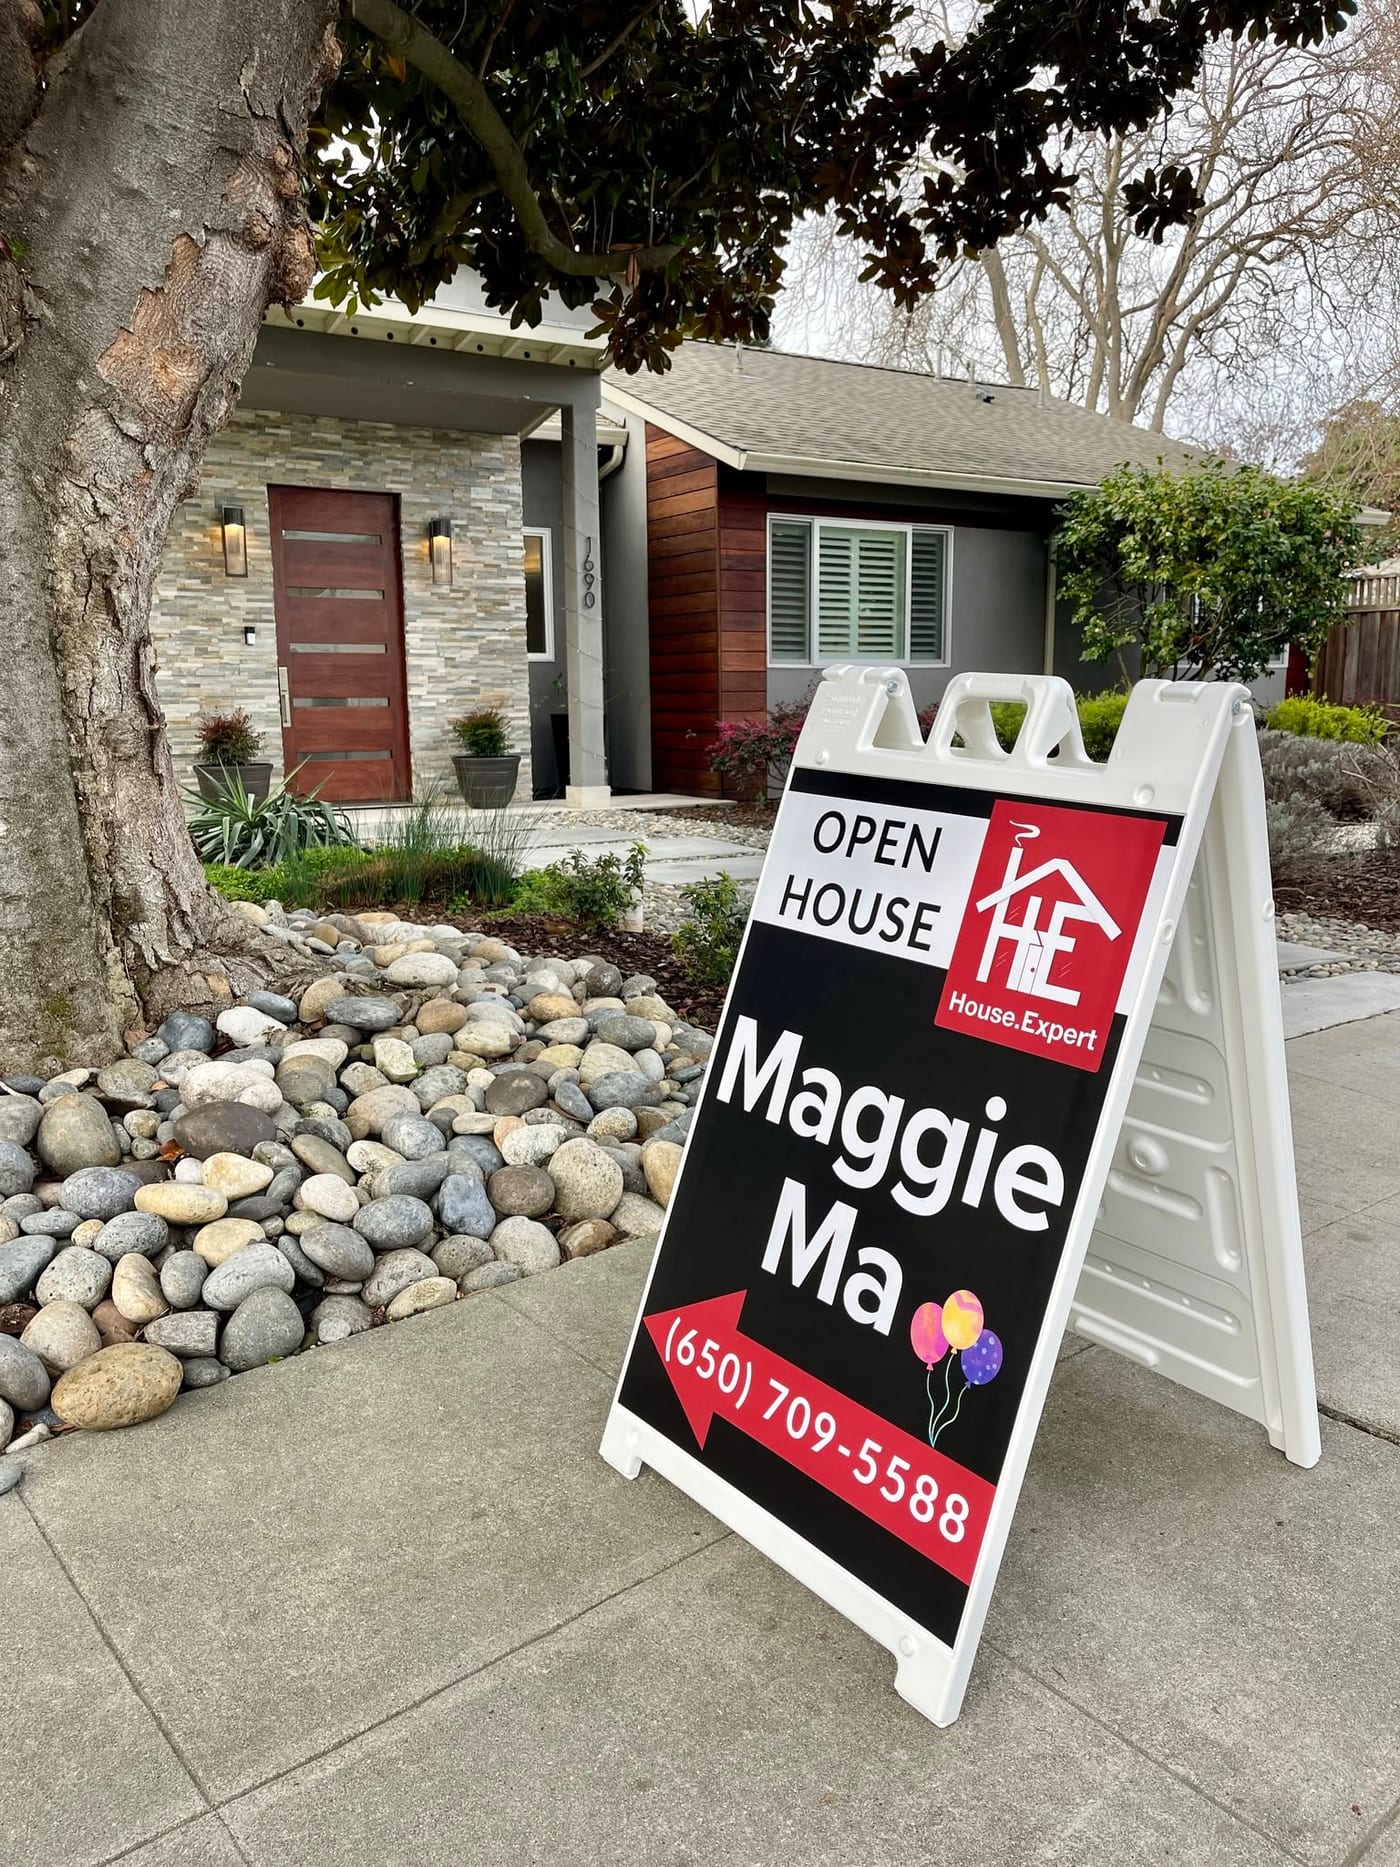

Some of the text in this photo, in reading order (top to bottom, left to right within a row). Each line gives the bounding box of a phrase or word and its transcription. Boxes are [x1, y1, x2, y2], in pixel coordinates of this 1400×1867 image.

[584, 536, 595, 609] 1690
[813, 810, 944, 873] OPEN
[778, 874, 942, 952] HOUSE
[948, 990, 1098, 1051] House.Expert
[716, 1014, 1065, 1232] Maggie
[761, 1176, 904, 1337] Ma
[664, 1316, 970, 1544] (650) 709-5588
